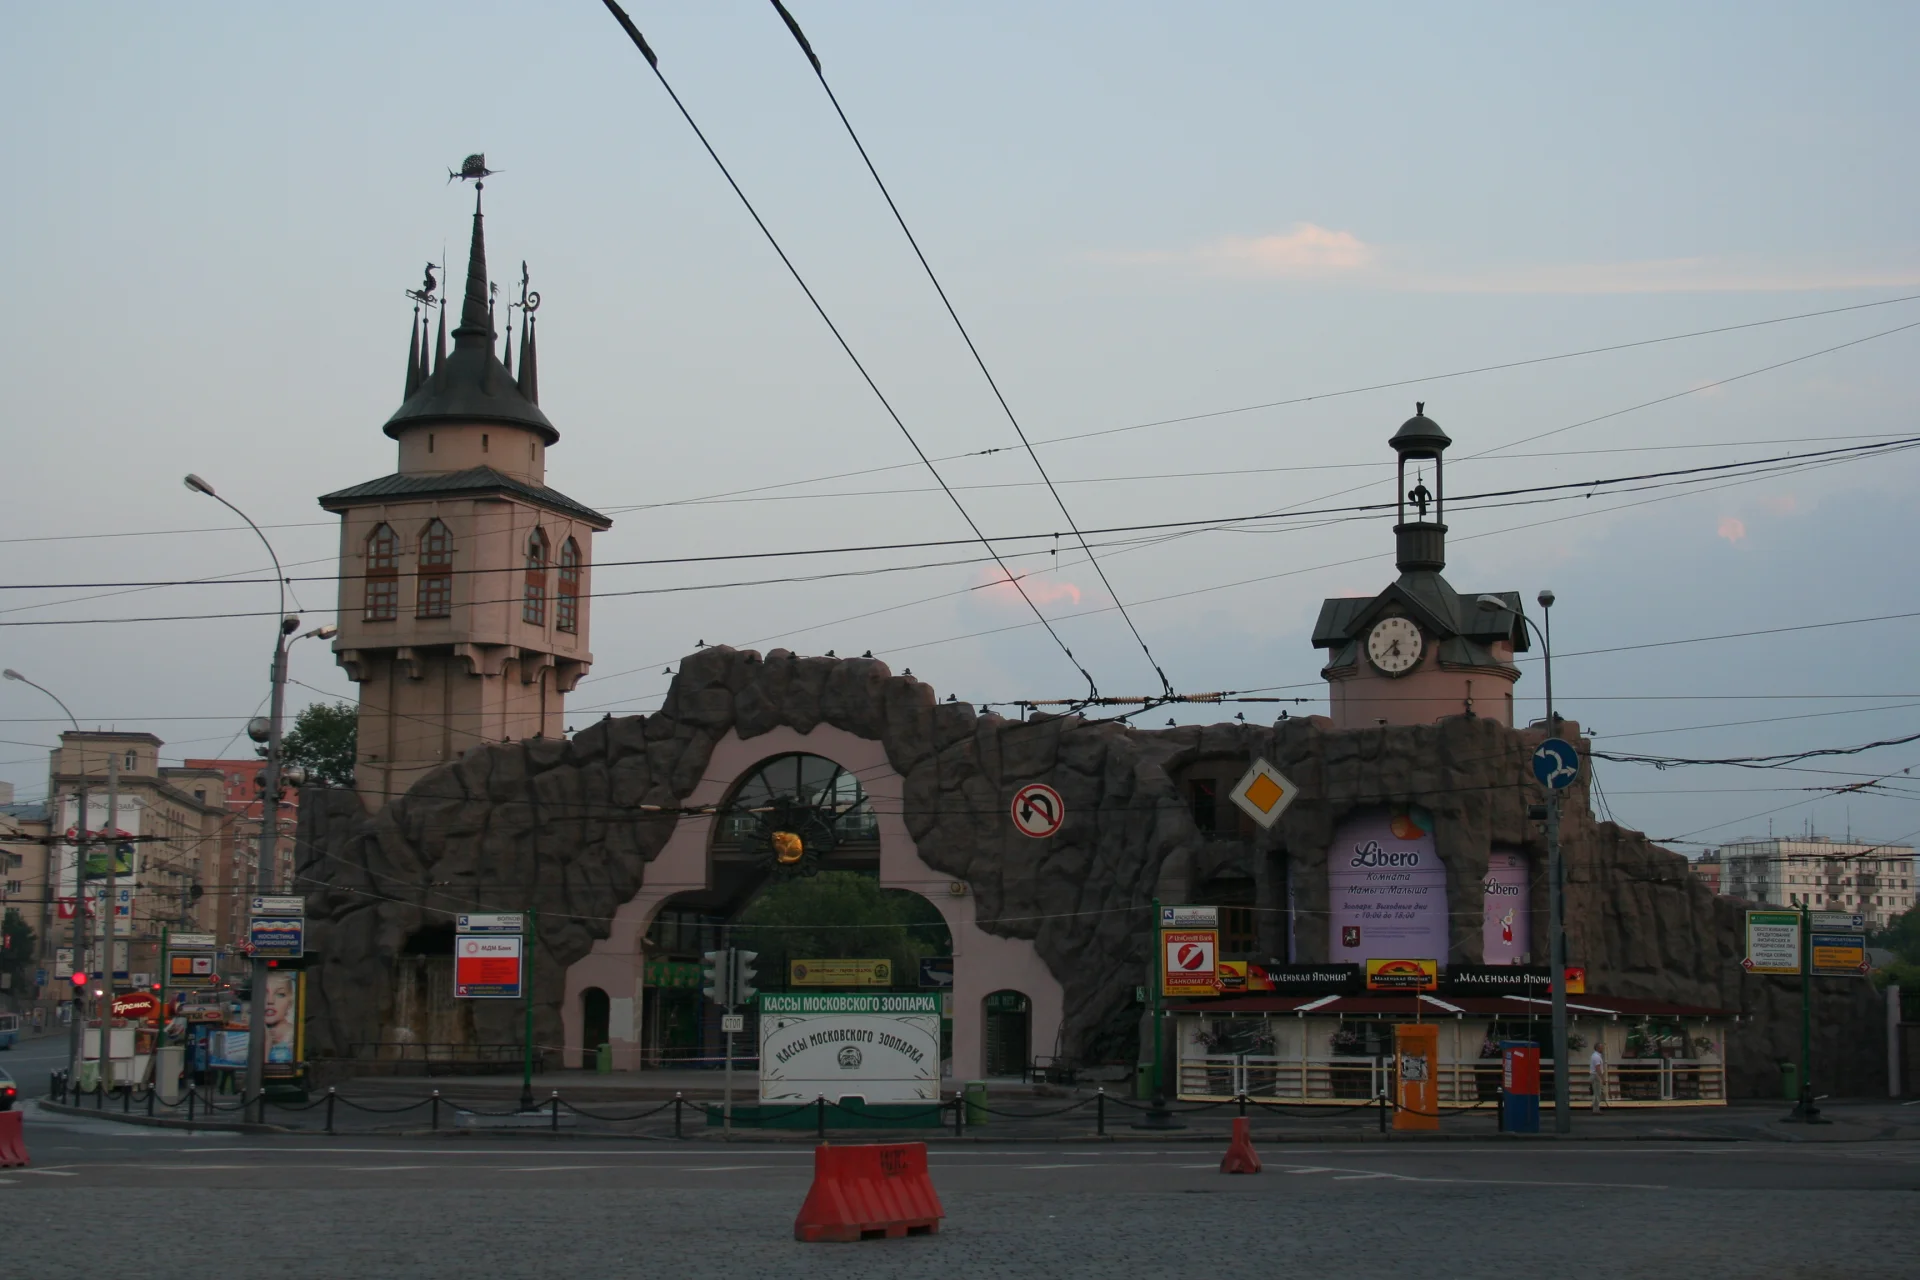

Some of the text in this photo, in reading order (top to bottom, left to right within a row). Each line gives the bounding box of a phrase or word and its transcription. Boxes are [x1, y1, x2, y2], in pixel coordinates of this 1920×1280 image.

[1350, 840, 1419, 867] Libero
[1366, 872, 1411, 881] Комната
[1347, 885, 1377, 894] Мамы
[1387, 885, 1428, 894] Малыша
[1484, 877, 1519, 896] Libero
[1375, 902, 1412, 910] Выходные
[481, 944, 497, 952] МДМ
[112, 1000, 152, 1015] Теремок
[764, 996, 936, 1011] КАССЫ МОСКОВСКОГО ЗООПАРКА
[725, 1018, 741, 1029] СТОП
[776, 1029, 924, 1064] КАССЫ МОСКОВСКОГО ЗООПАРКА
